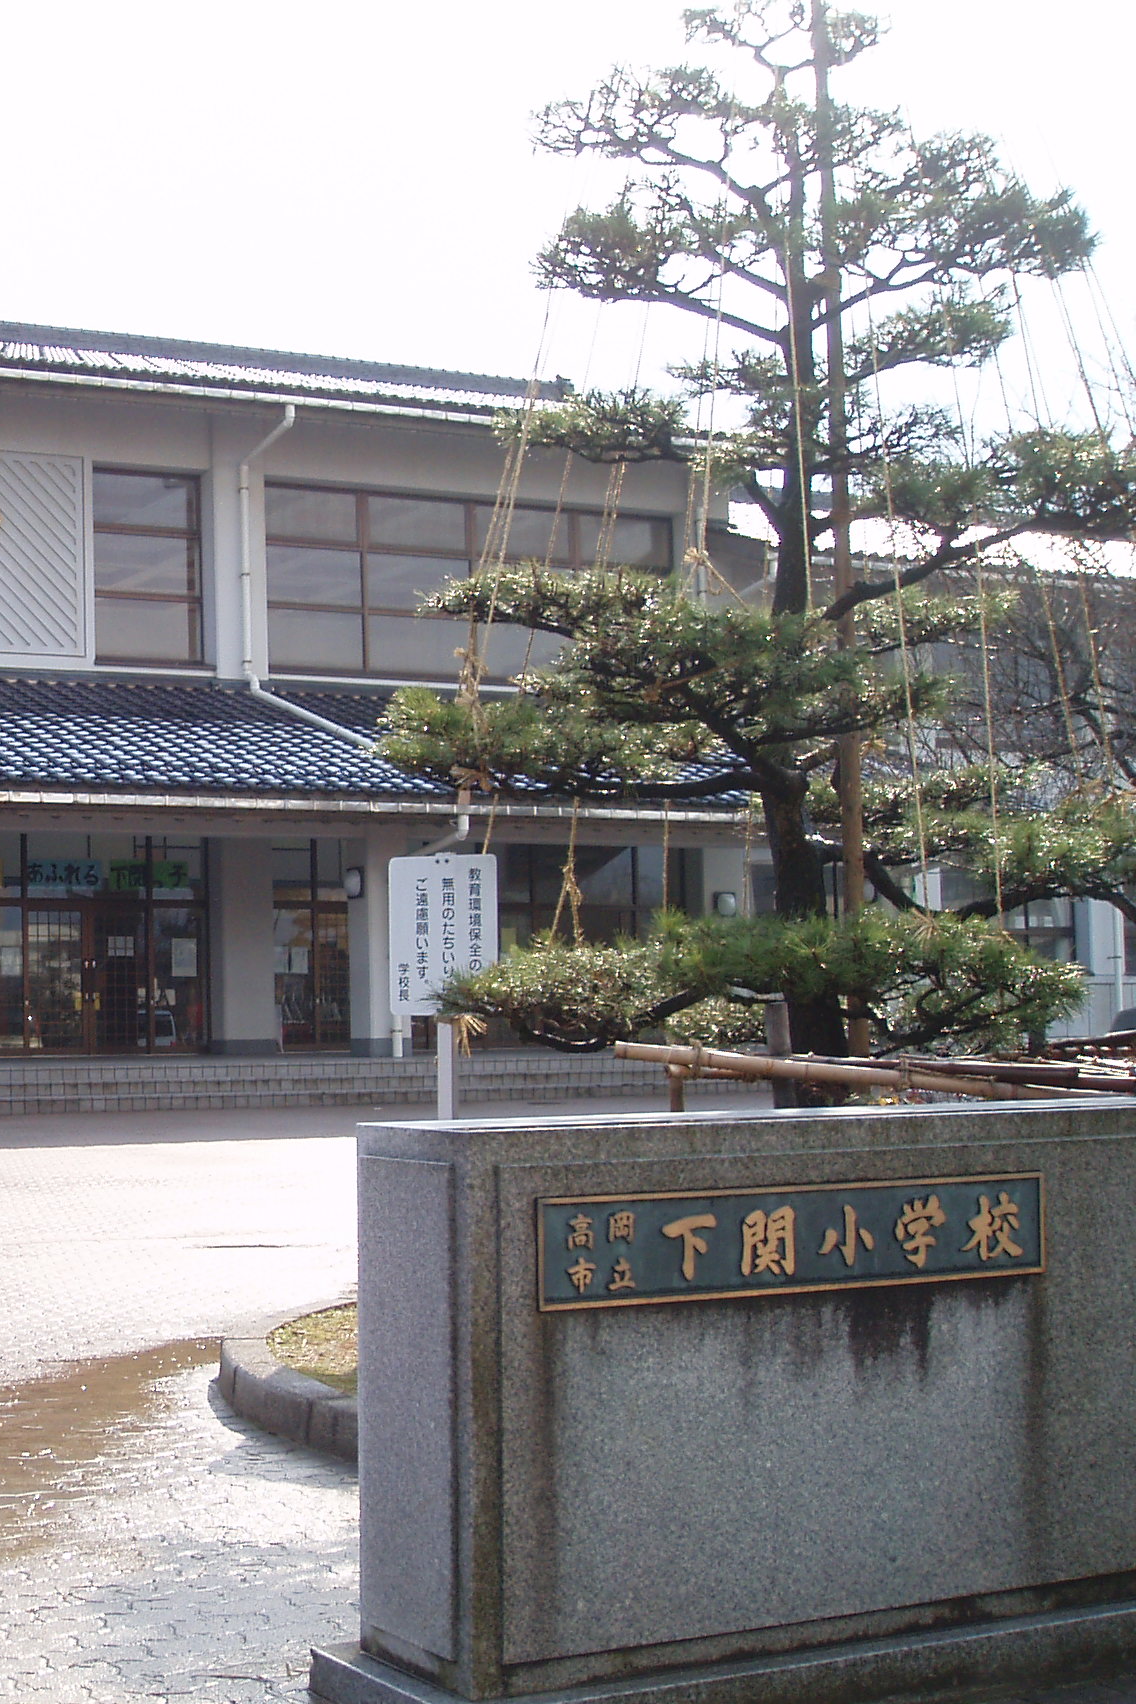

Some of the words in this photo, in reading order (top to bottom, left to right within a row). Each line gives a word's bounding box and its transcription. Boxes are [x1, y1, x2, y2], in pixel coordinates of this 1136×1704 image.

[398, 963, 410, 1001] 学校長
[567, 1211, 636, 1252] 高岡
[662, 1191, 1024, 1281] 下関小学校
[566, 1257, 636, 1294] 市立
